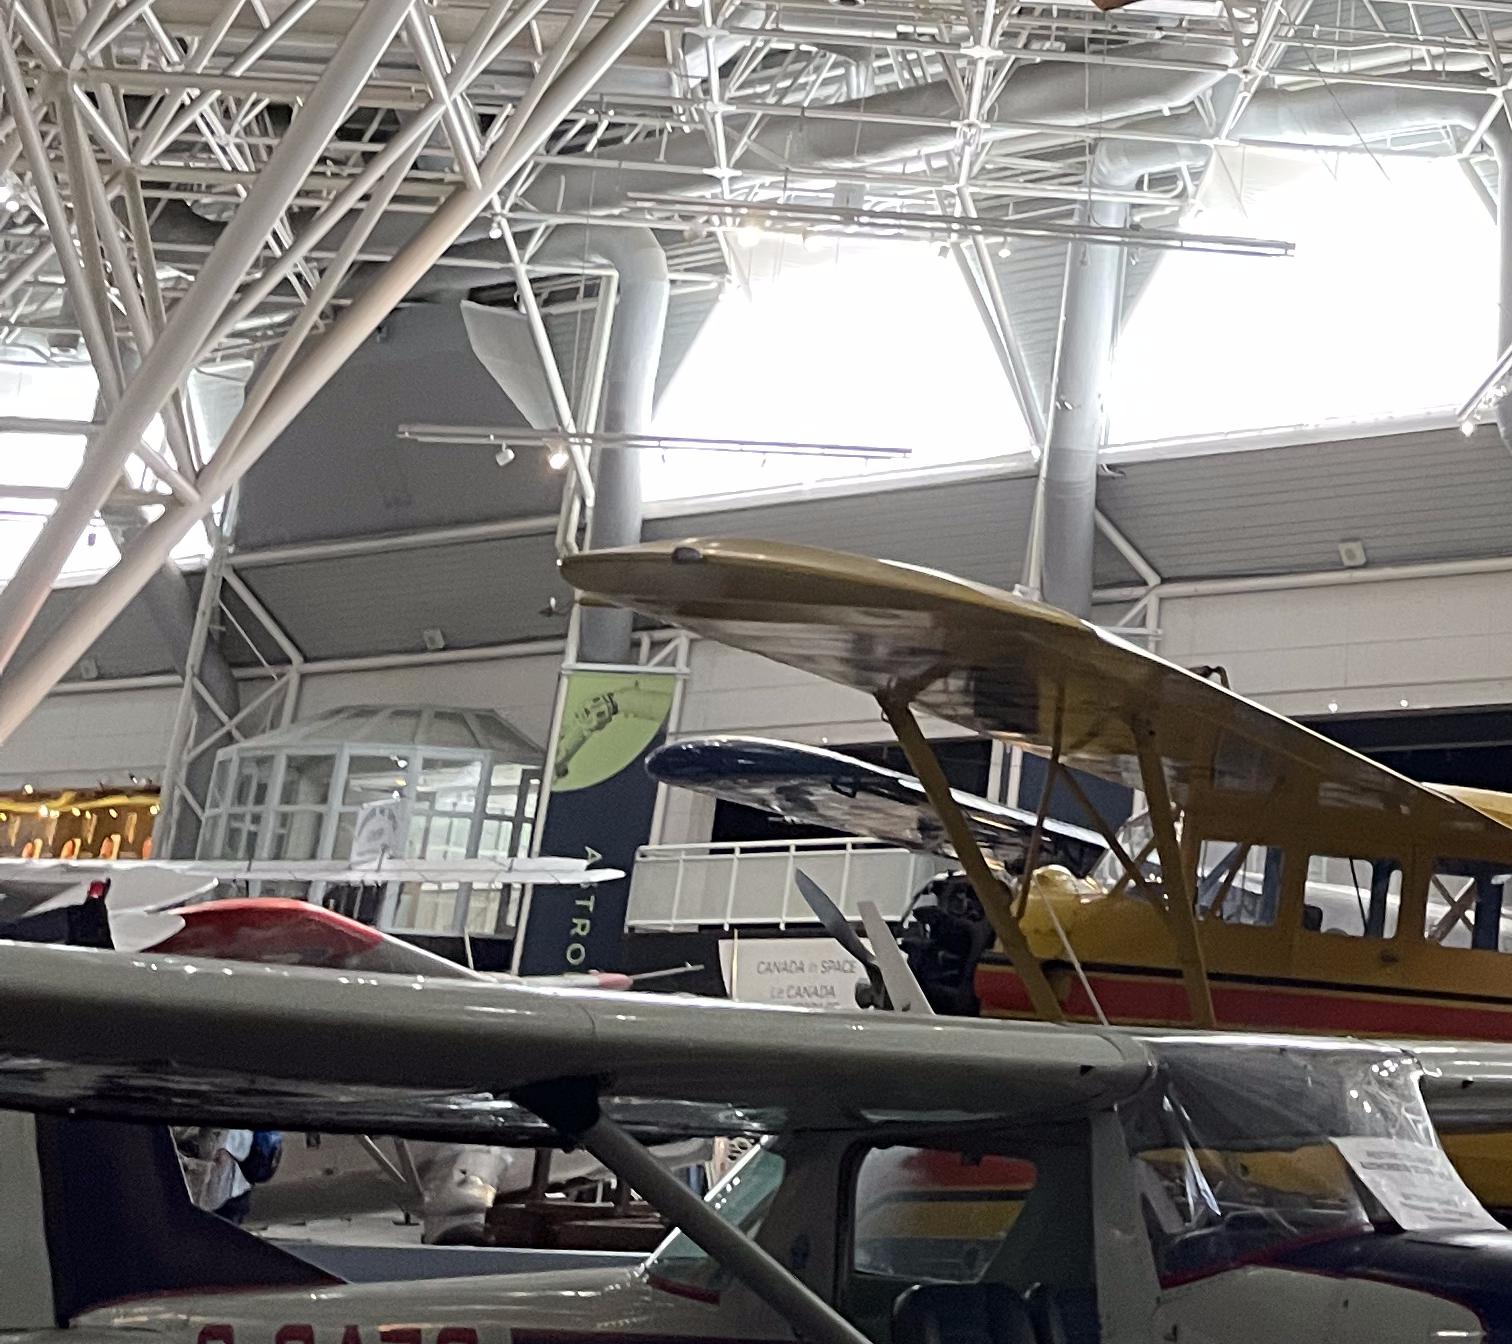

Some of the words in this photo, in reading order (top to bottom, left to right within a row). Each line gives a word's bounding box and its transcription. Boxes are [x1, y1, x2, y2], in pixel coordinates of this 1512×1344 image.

[566, 845, 603, 965] ATRO
[756, 961, 804, 974] CANADA
[821, 960, 857, 974] SPACE
[786, 984, 836, 998] CANADA
